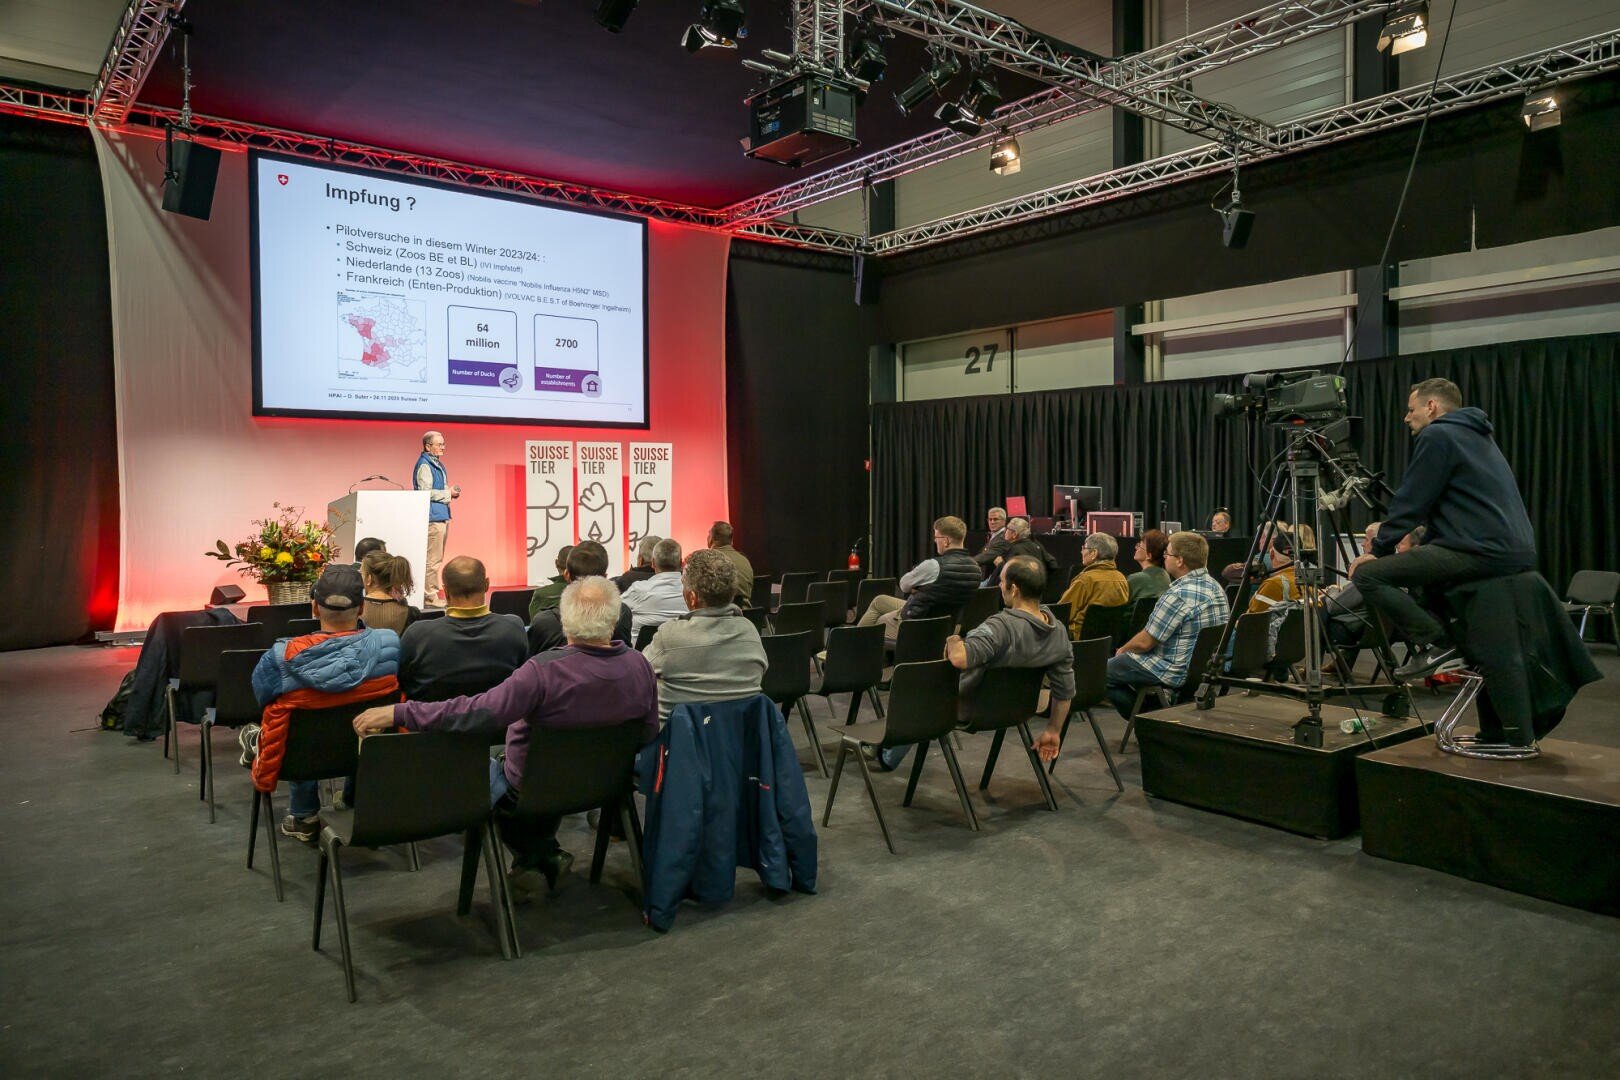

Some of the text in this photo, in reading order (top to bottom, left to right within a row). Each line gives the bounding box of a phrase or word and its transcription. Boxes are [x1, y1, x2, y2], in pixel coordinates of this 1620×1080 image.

[326, 183, 416, 212] Impfung ?
[336, 224, 410, 244] Pilotversuche
[413, 235, 423, 246] in
[426, 237, 463, 251] diesem
[465, 242, 498, 256] Winter
[346, 240, 393, 256] Schweiz
[395, 247, 426, 261] (Zoos
[429, 252, 444, 263] BE
[447, 255, 457, 264] et
[460, 256, 477, 269] BL)
[346, 256, 413, 274] Niederlande
[416, 265, 432, 277] (13
[435, 267, 465, 281] Zoos)
[544, 284, 571, 293] Influenza
[346, 271, 404, 287] Frankreich
[408, 279, 502, 300] (Enten-Produktion)
[476, 323, 489, 333] 64
[466, 338, 500, 349] million
[555, 338, 578, 349] 2700
[965, 343, 999, 375] 27
[452, 369, 473, 377] Number
[480, 370, 495, 378] Ducks
[530, 445, 570, 460] SUISSE
[581, 446, 618, 460] SUISSE
[633, 447, 669, 461] SUISSE
[530, 461, 555, 474] TIER
[581, 461, 605, 474] TIER
[634, 461, 656, 475] TIER
